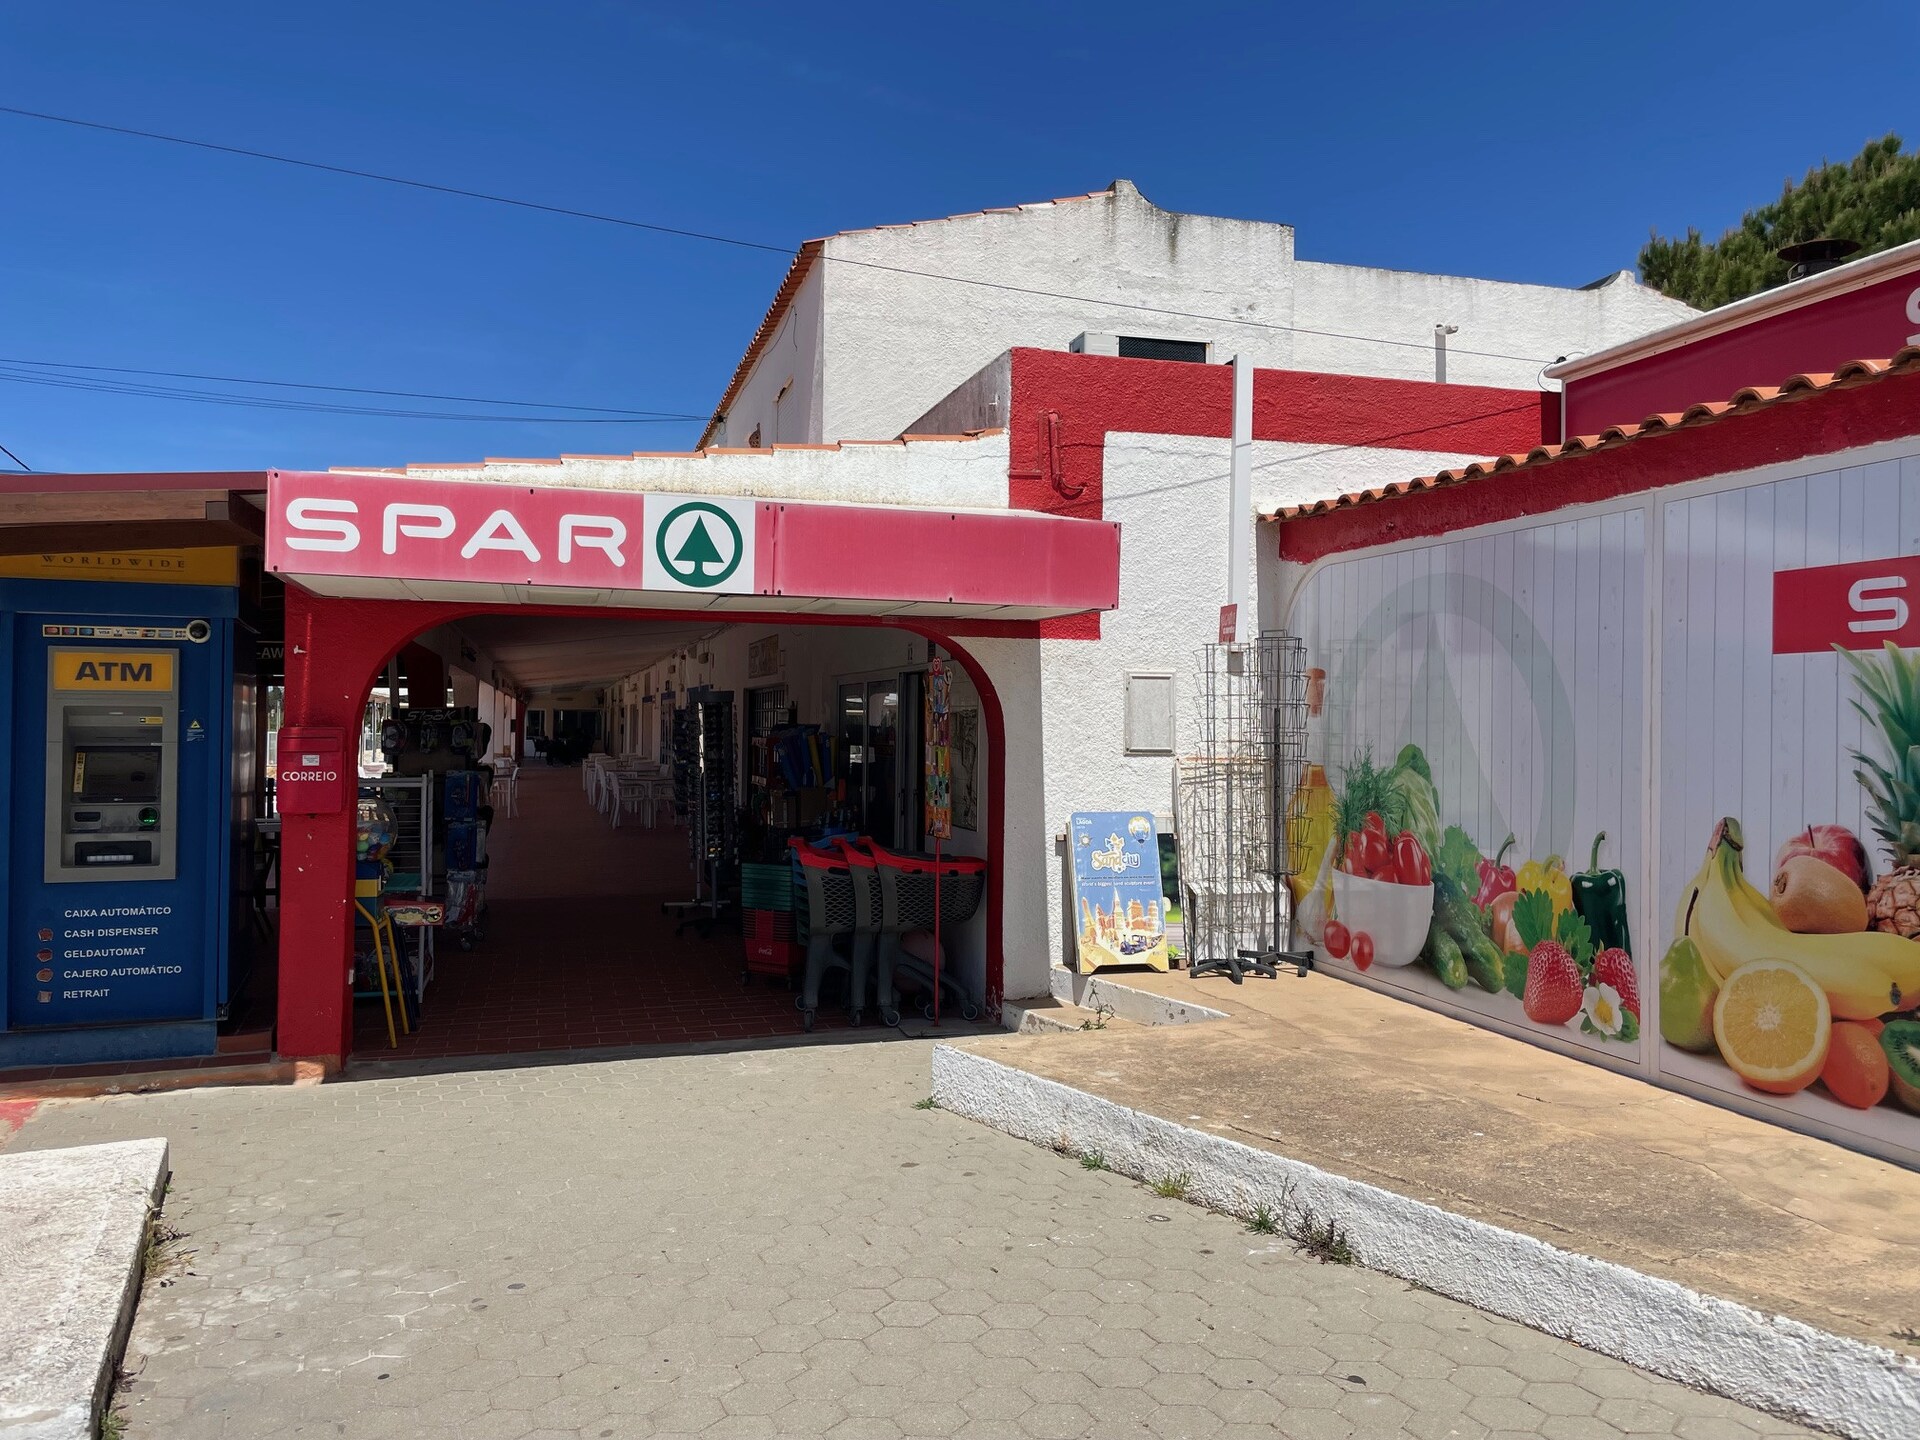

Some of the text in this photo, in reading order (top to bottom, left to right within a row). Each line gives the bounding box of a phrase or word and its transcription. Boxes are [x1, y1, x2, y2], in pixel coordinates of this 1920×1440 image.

[285, 497, 627, 568] SPAR
[41, 554, 185, 569] WORLDWIDE
[75, 661, 152, 682] ATM
[281, 771, 337, 782] CORREIO
[64, 905, 172, 918] CAIXA AUTOMÁTICO
[64, 926, 159, 938] CASH DISPENSER
[63, 947, 146, 959] GELDAUTOMAT
[63, 965, 182, 979] CAJERO AUTOMÁTICO
[63, 988, 110, 999] RETRAIT
